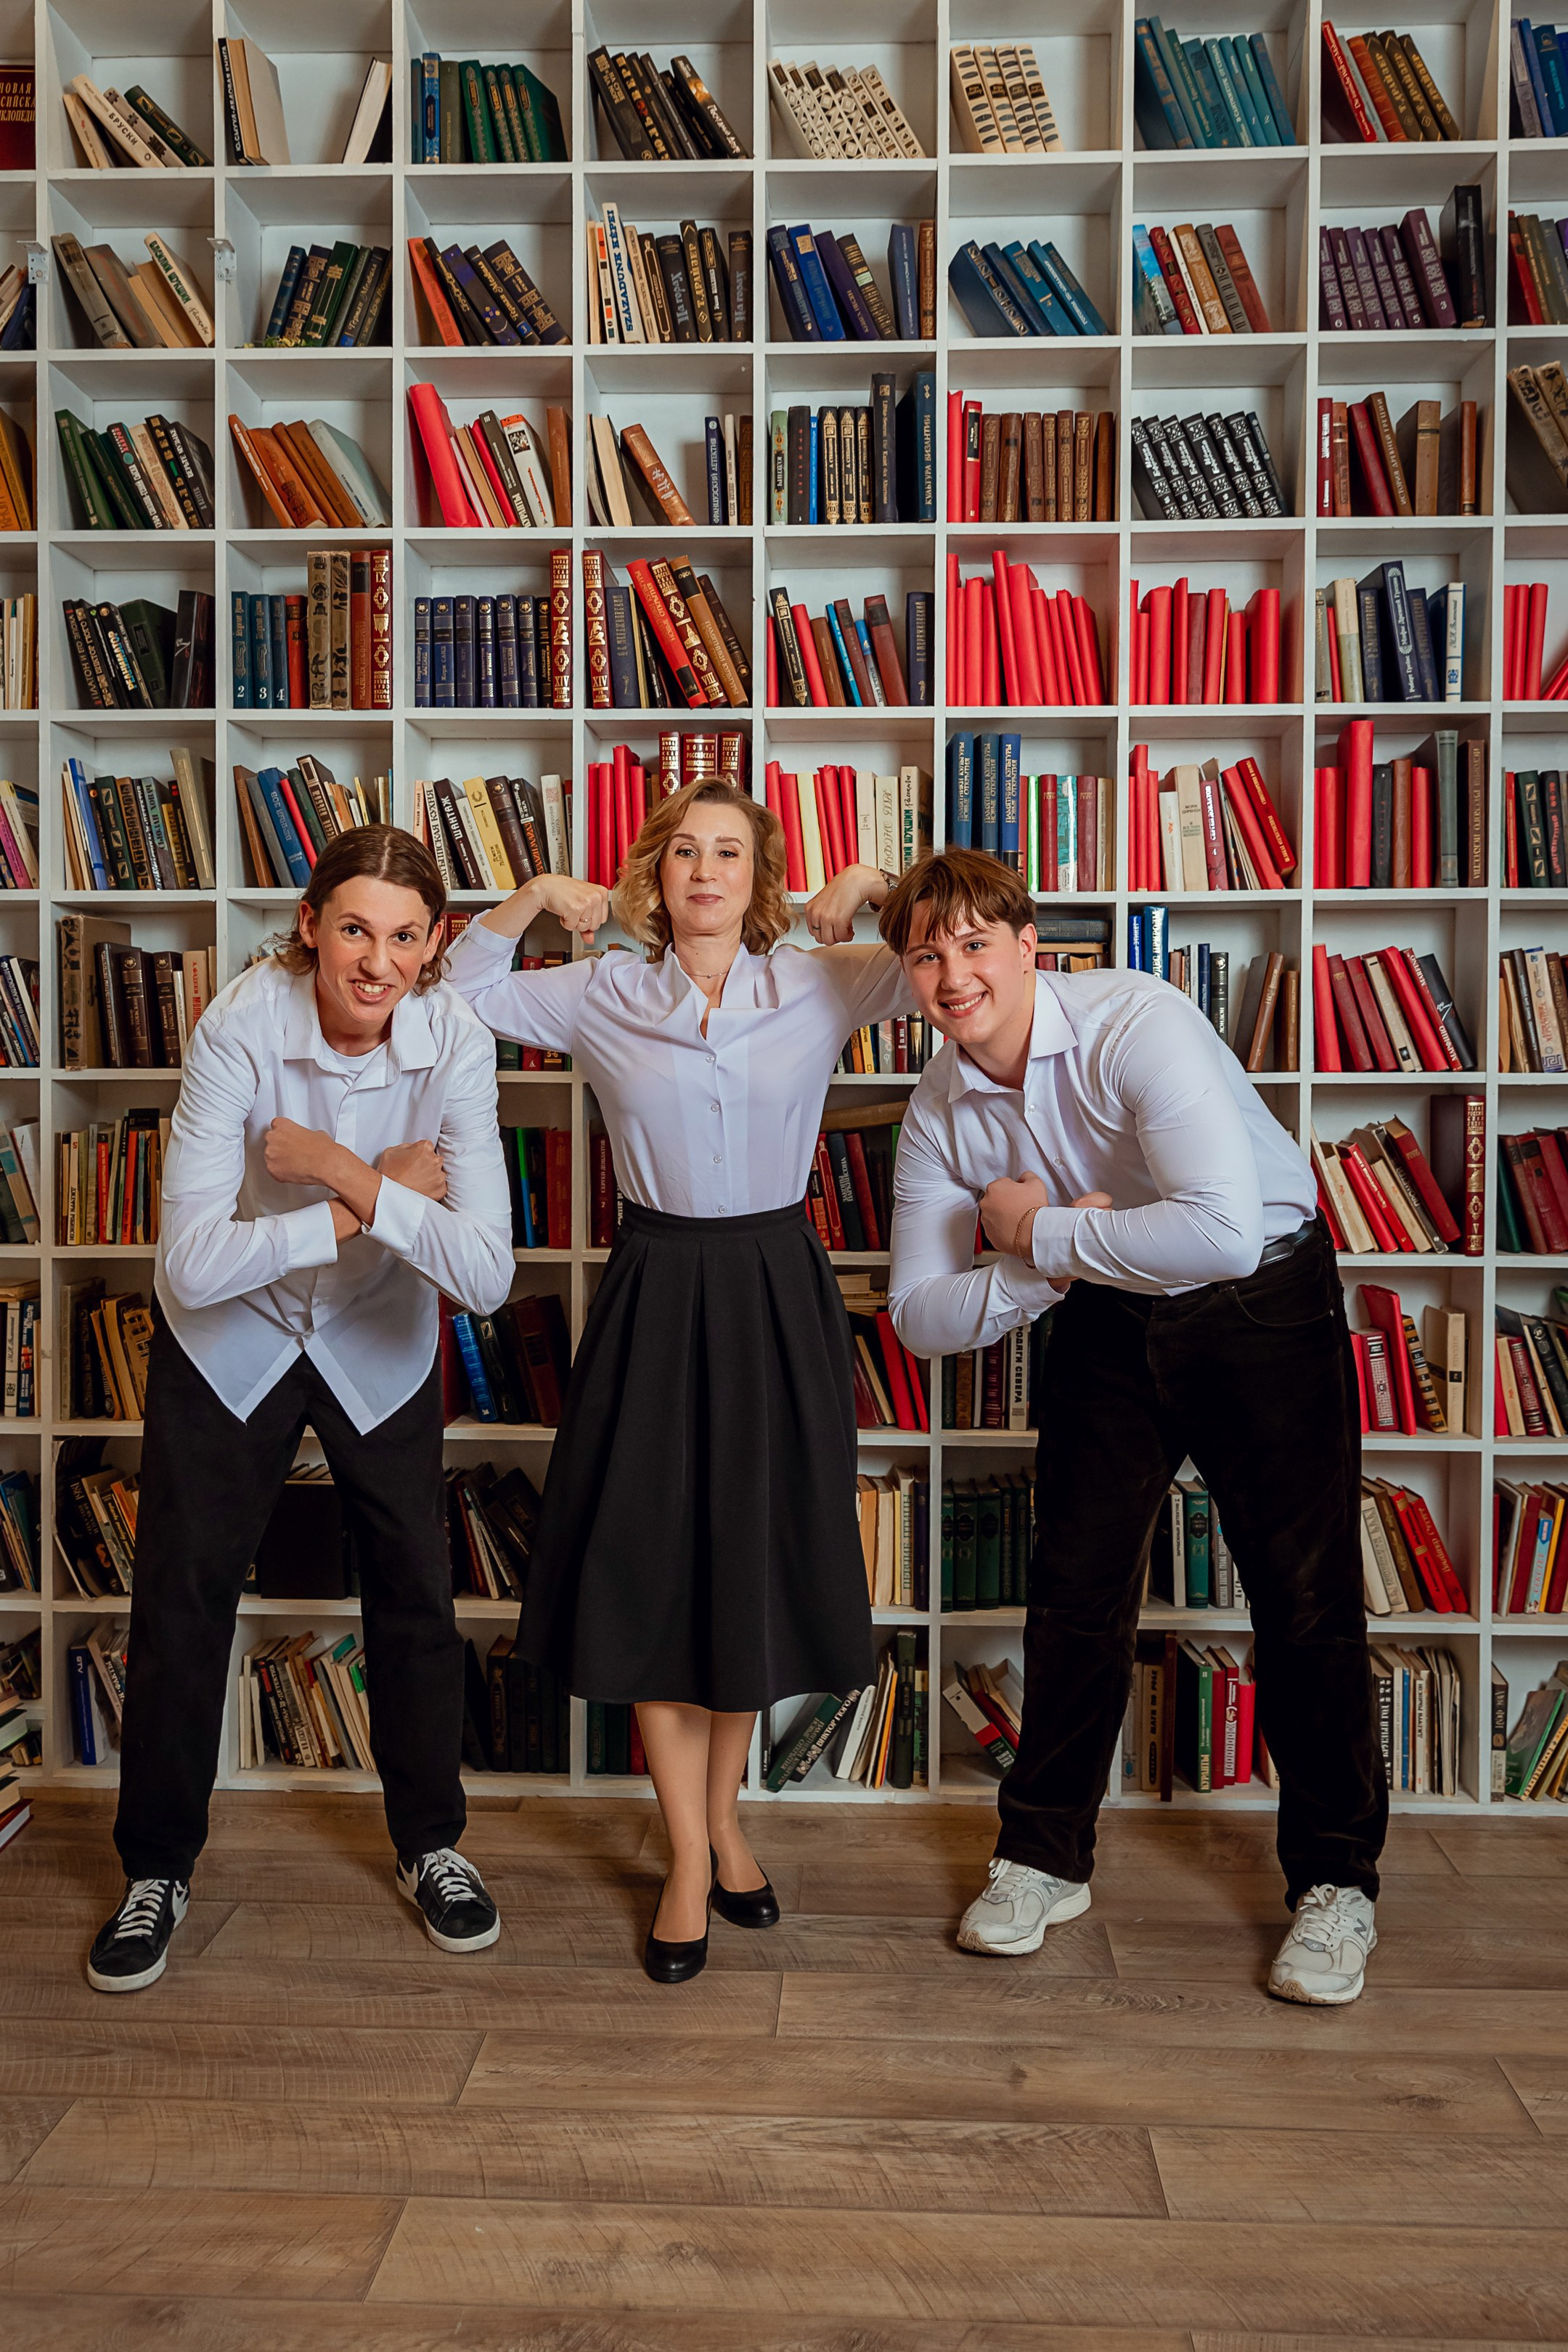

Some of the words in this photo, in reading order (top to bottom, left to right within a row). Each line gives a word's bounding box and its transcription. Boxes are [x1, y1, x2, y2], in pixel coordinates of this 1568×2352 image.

[221, 45, 230, 71] КНИГА
[107, 112, 139, 145] БРУСКИ
[605, 209, 620, 250] KÉPEI
[686, 242, 705, 308] Т.ДРАЙЗЕР
[498, 292, 520, 321] Герман
[612, 252, 633, 332] SZÁZADUNK
[346, 301, 365, 331] Герман
[1375, 398, 1389, 432] ГРЕЦИИ
[113, 427, 128, 452] ЛАВРОВ
[150, 417, 173, 460] ВЕРН
[923, 415, 932, 460] ВИЗАНТИИ
[1384, 434, 1398, 468] ДРЕВНЕЙ
[711, 473, 720, 523] ФРАНЦУЗСКИЙ
[923, 465, 932, 505] КУЛЬТУРА
[1392, 470, 1406, 505] ИСТОРИЯ
[67, 614, 81, 640] ЭПОХА
[78, 620, 93, 644] ГЮГО
[86, 644, 102, 674] ВИКТОР
[105, 629, 139, 690] РЕАНИМАТОР
[79, 662, 98, 700] ПЛАТОН
[237, 685, 245, 698] 2
[259, 687, 267, 699] 3
[277, 688, 285, 701] 4
[554, 675, 569, 686] XIV
[593, 675, 607, 687] XIV
[701, 672, 716, 686] VIII
[270, 790, 281, 808] ЗОВ
[425, 789, 438, 822] КУХНЯ
[1472, 789, 1481, 830] РУССКОГО
[441, 795, 462, 840] ШАНТАЖ
[903, 809, 912, 843] ШУКШИН
[489, 846, 498, 862] Джек
[494, 843, 505, 867] Лондон
[1472, 834, 1481, 879] ИСКУССТВА
[1149, 910, 1163, 953] ПРИРОДЫ
[1151, 955, 1161, 978] УДЕС
[838, 1175, 849, 1202] ЗАКОНЫ
[1395, 1165, 1420, 1207] ПРОМЕТЕЙ
[816, 1719, 838, 1747] ВИКТОР
[833, 1699, 852, 1721] ГЮГО
[1380, 1704, 1389, 1718] ГОД
[1199, 1754, 1210, 1789] КУРАНТЫ
